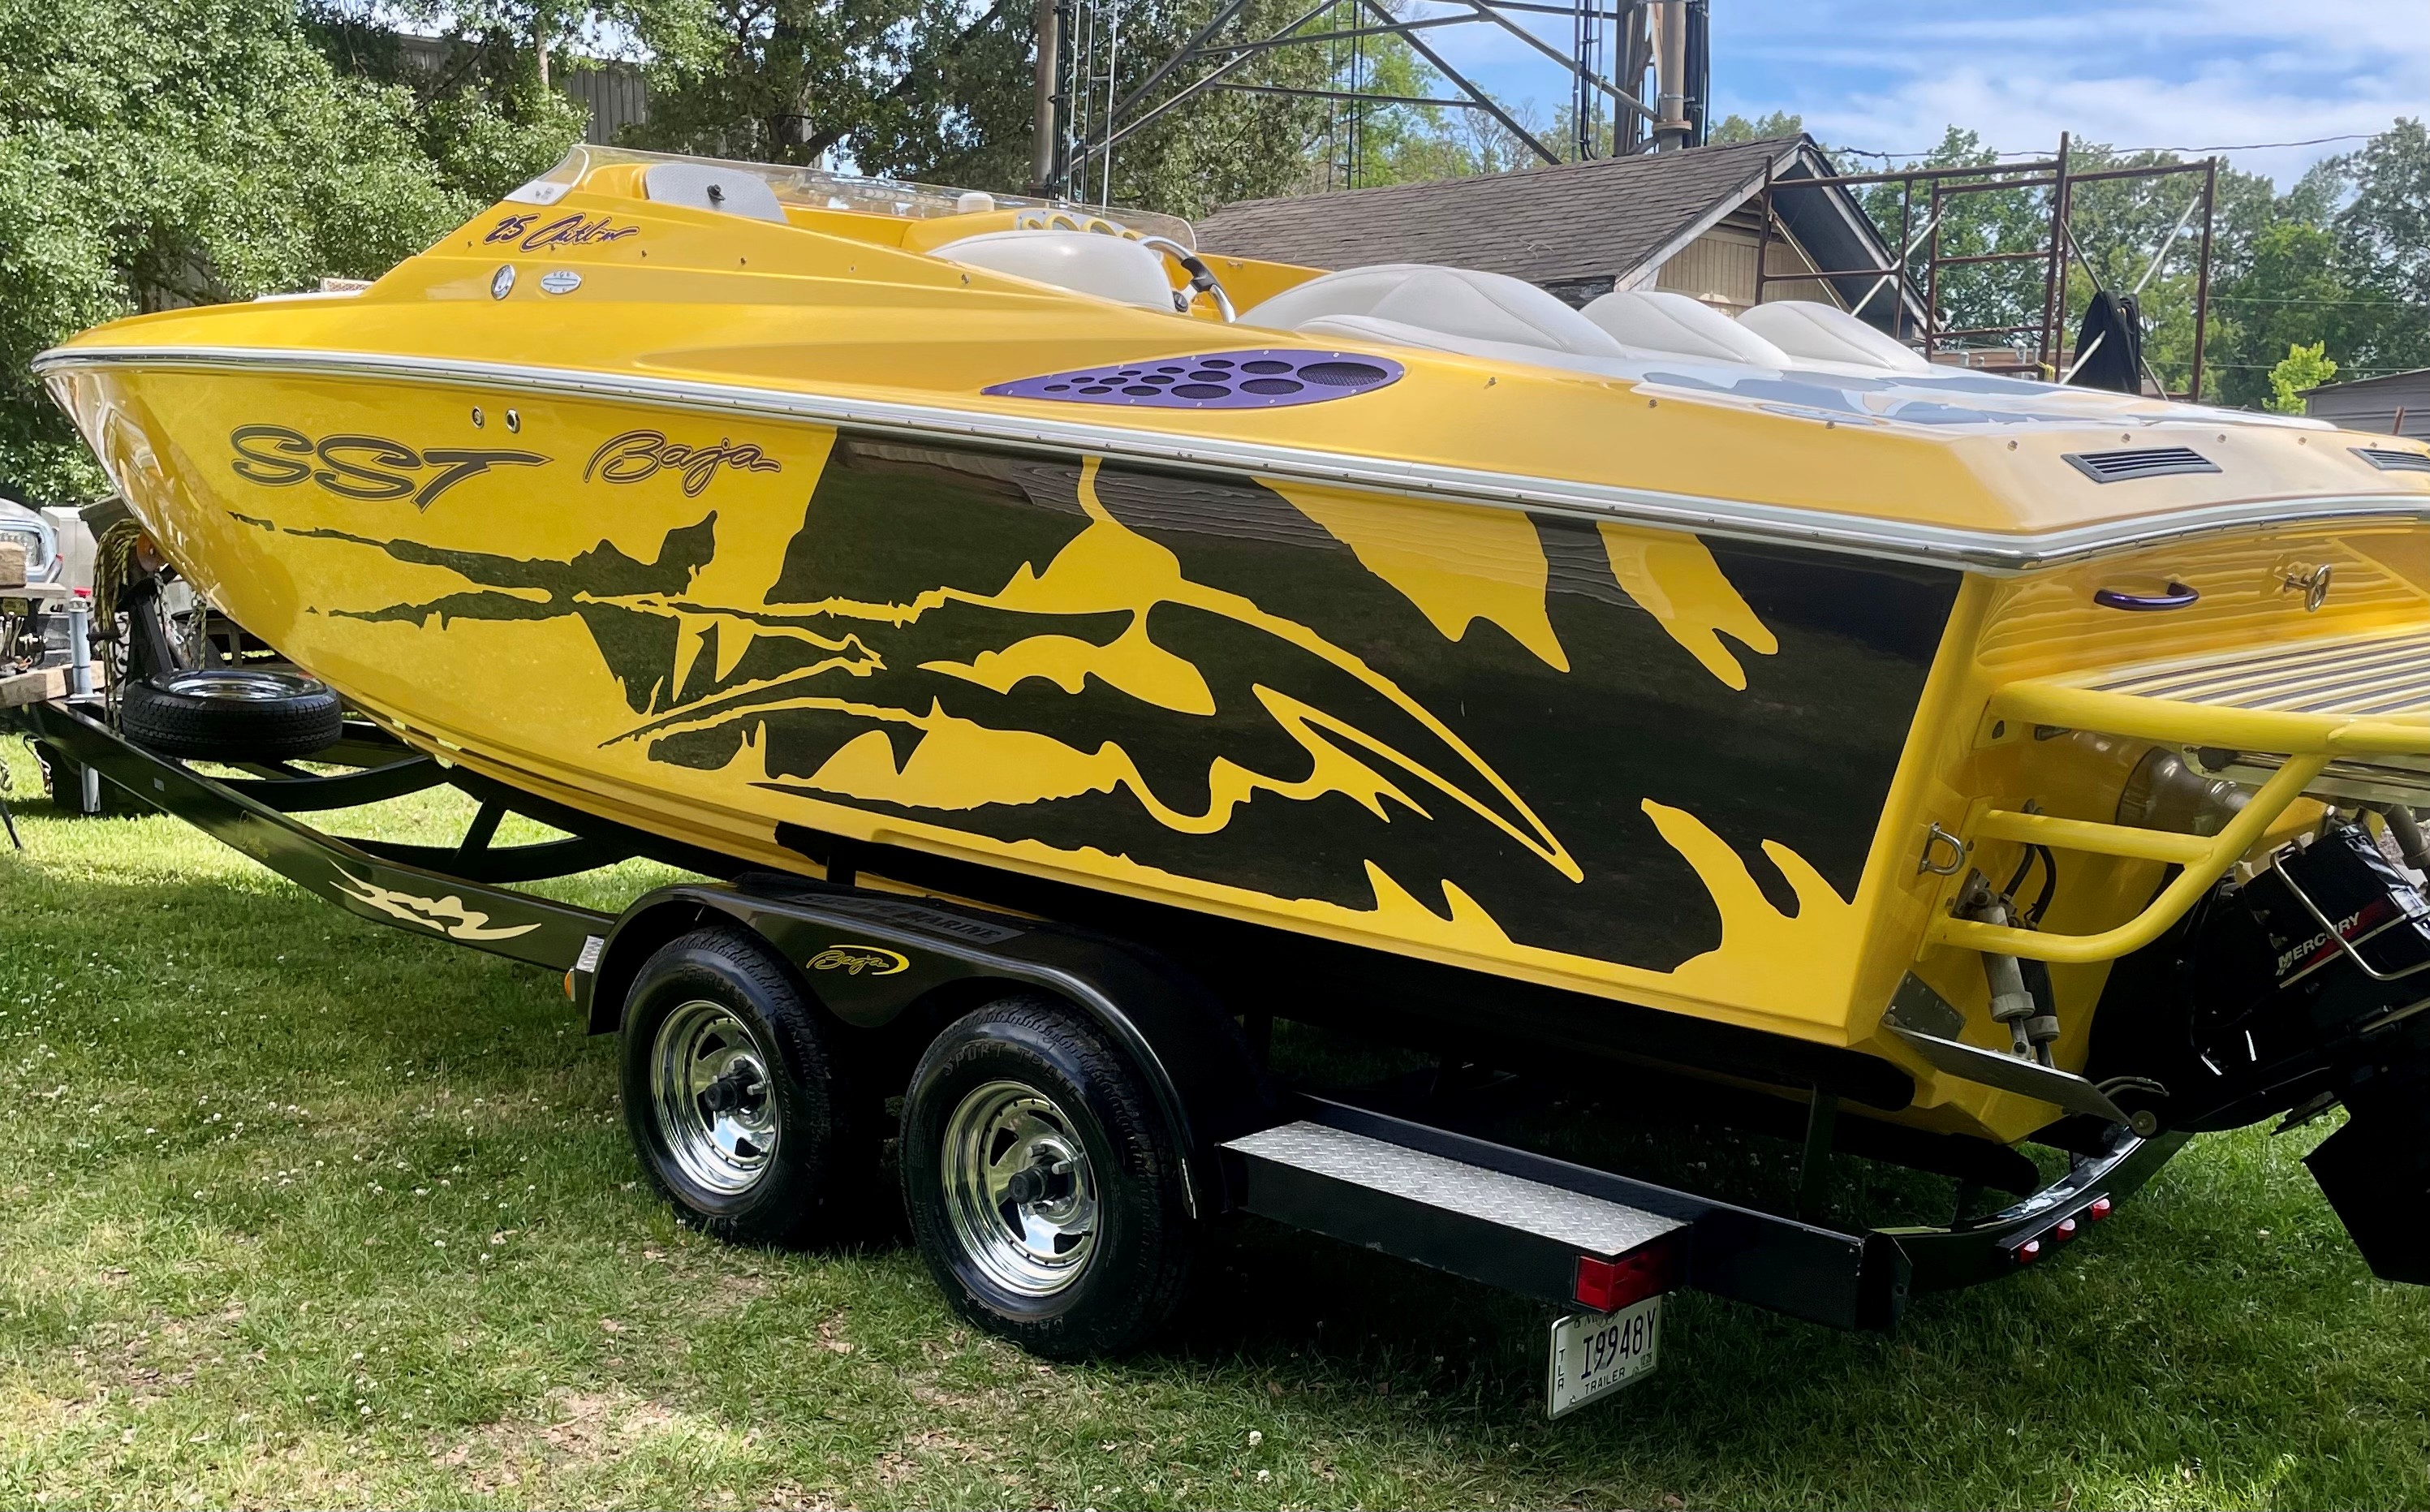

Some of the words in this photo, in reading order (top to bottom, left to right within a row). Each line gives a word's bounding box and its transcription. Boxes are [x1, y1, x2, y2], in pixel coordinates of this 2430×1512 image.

[231, 424, 554, 513] SST
[583, 429, 781, 497] Baja
[806, 950, 890, 975] Baja
[942, 1042, 1006, 1076] SPORT
[1581, 1307, 1656, 1380] I9948Y
[1584, 1367, 1626, 1395] TRAILER
